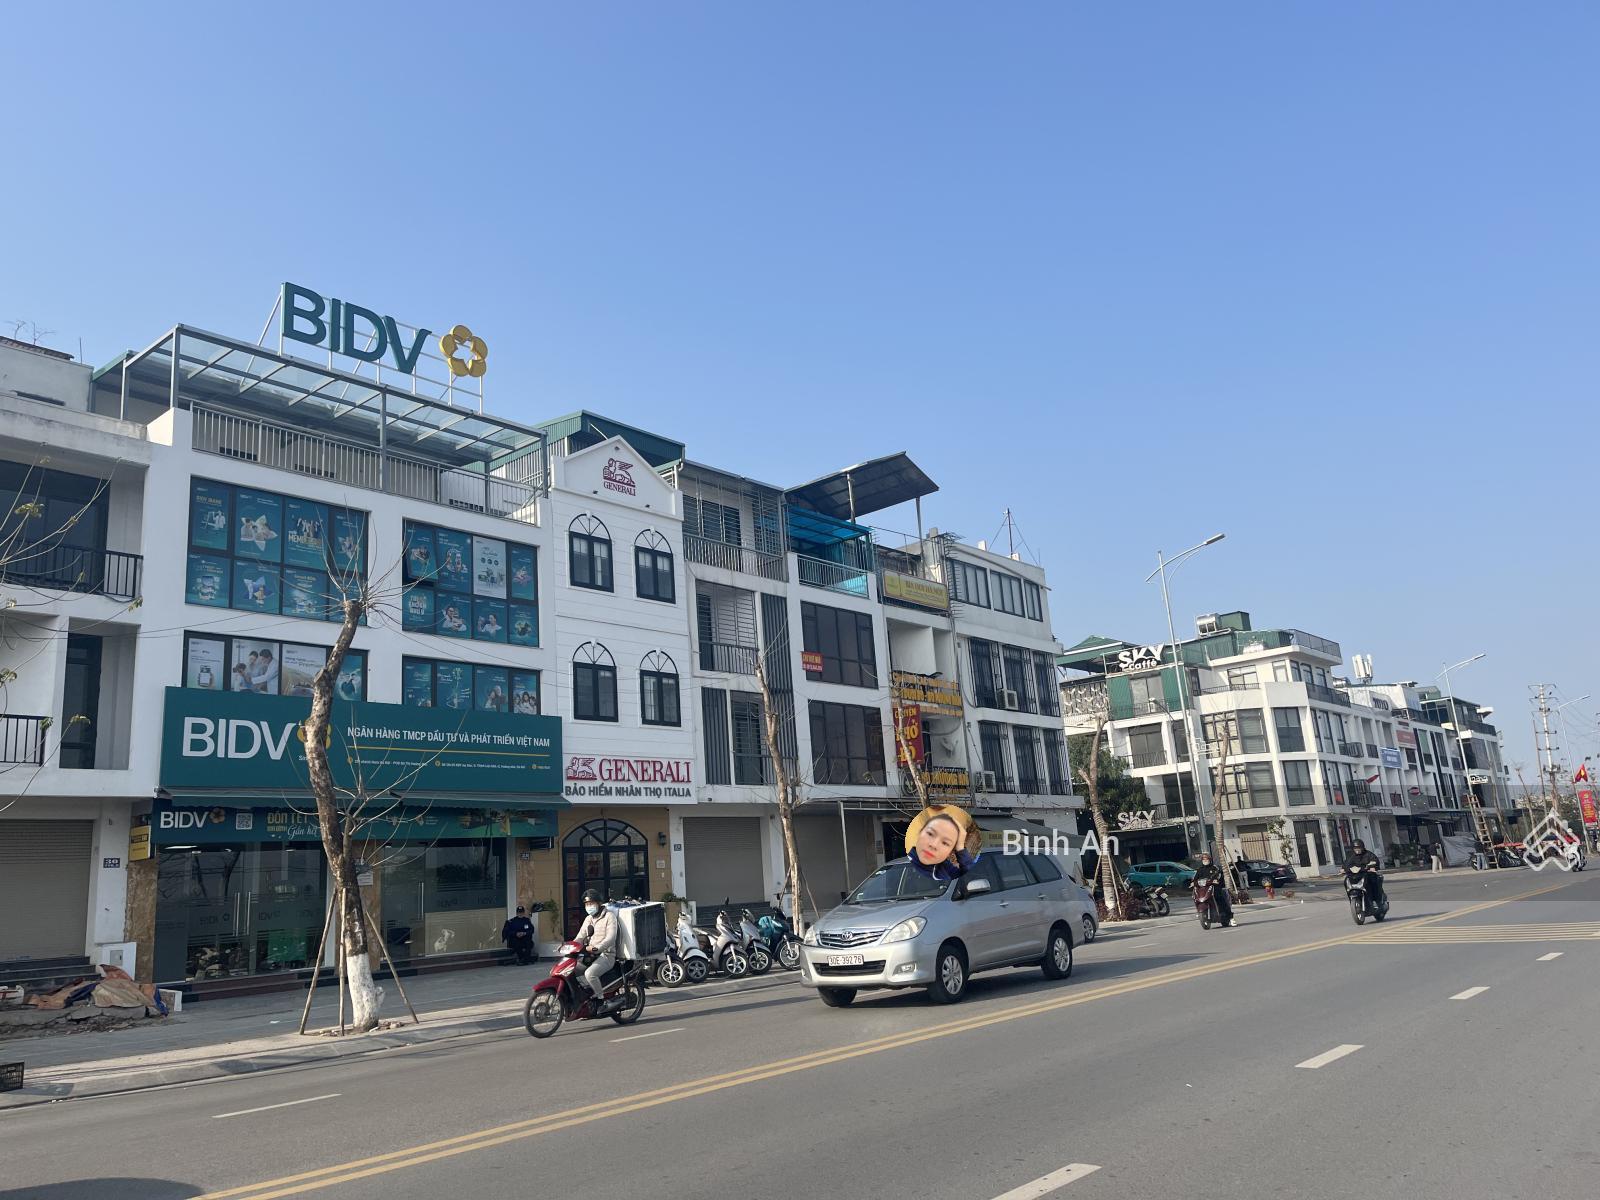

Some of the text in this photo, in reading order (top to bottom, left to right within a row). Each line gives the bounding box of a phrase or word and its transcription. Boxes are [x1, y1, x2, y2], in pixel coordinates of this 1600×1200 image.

[283, 282, 431, 374] BIDV
[603, 481, 636, 496] GENERALI
[1118, 643, 1165, 669] SKY
[182, 716, 297, 760] BIDV
[347, 724, 374, 739] NGÂN
[375, 725, 401, 740] HÀNG
[402, 730, 426, 741] TMCP
[459, 730, 470, 743] VÀ
[471, 730, 491, 744] PHÁT
[515, 733, 533, 747] VIỆT
[533, 737, 550, 747] NAM
[599, 758, 692, 783] GENERALI
[565, 782, 692, 799] BẢO HIỂM NHÂN THỌ ITALIA
[160, 811, 208, 829] BIDV
[1117, 810, 1156, 831] SKY
